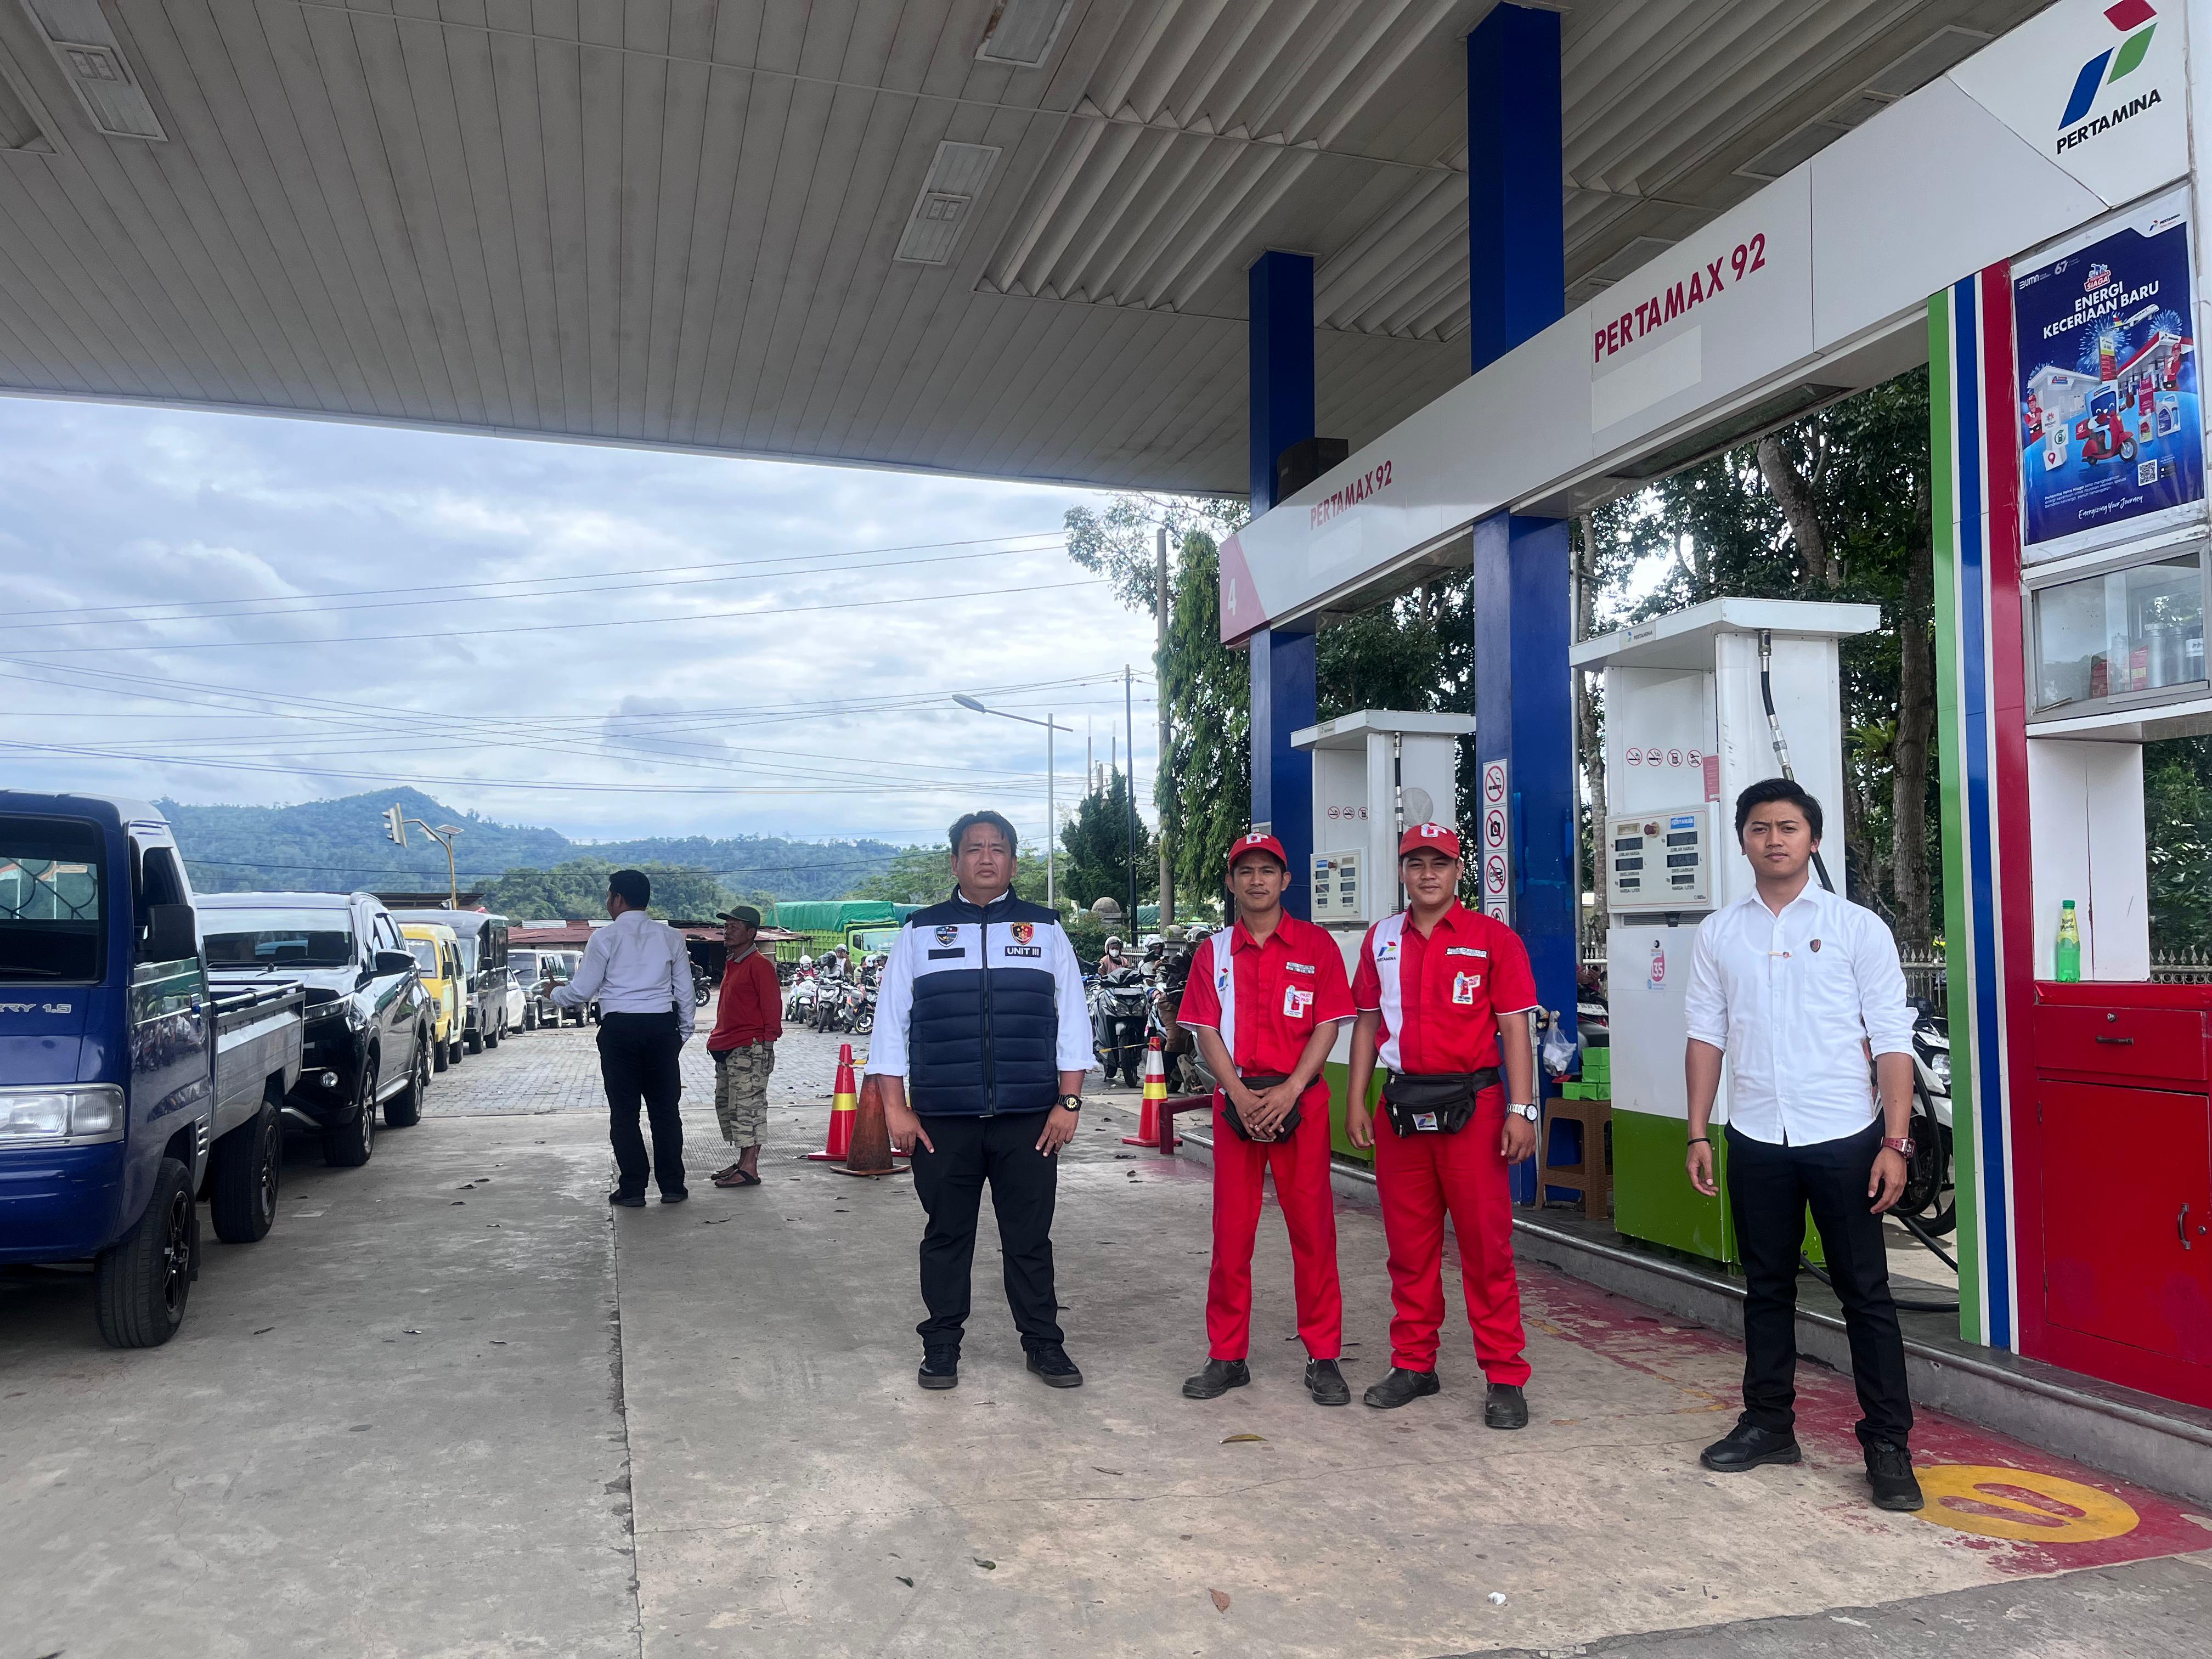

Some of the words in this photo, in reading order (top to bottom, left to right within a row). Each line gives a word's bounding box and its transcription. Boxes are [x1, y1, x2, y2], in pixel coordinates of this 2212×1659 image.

[2056, 88, 2162, 155] PERTAMINA
[2055, 260, 2068, 275] 67
[2086, 276, 2109, 290] SIAGA
[1595, 256, 1724, 363] PERTAMAX
[1731, 233, 1765, 282] 92
[2043, 301, 2117, 339] KECERIAAN
[2121, 280, 2159, 307] BARU
[2075, 281, 2123, 312] ENERGI
[1311, 471, 1373, 531] PERTAMAX
[1376, 460, 1392, 490] 92
[2078, 505, 2107, 520] Energizing
[2108, 501, 2120, 512] Your
[2120, 495, 2143, 509] Journey
[1228, 578, 1237, 616] 4
[43, 1003, 71, 1013] 1.5
